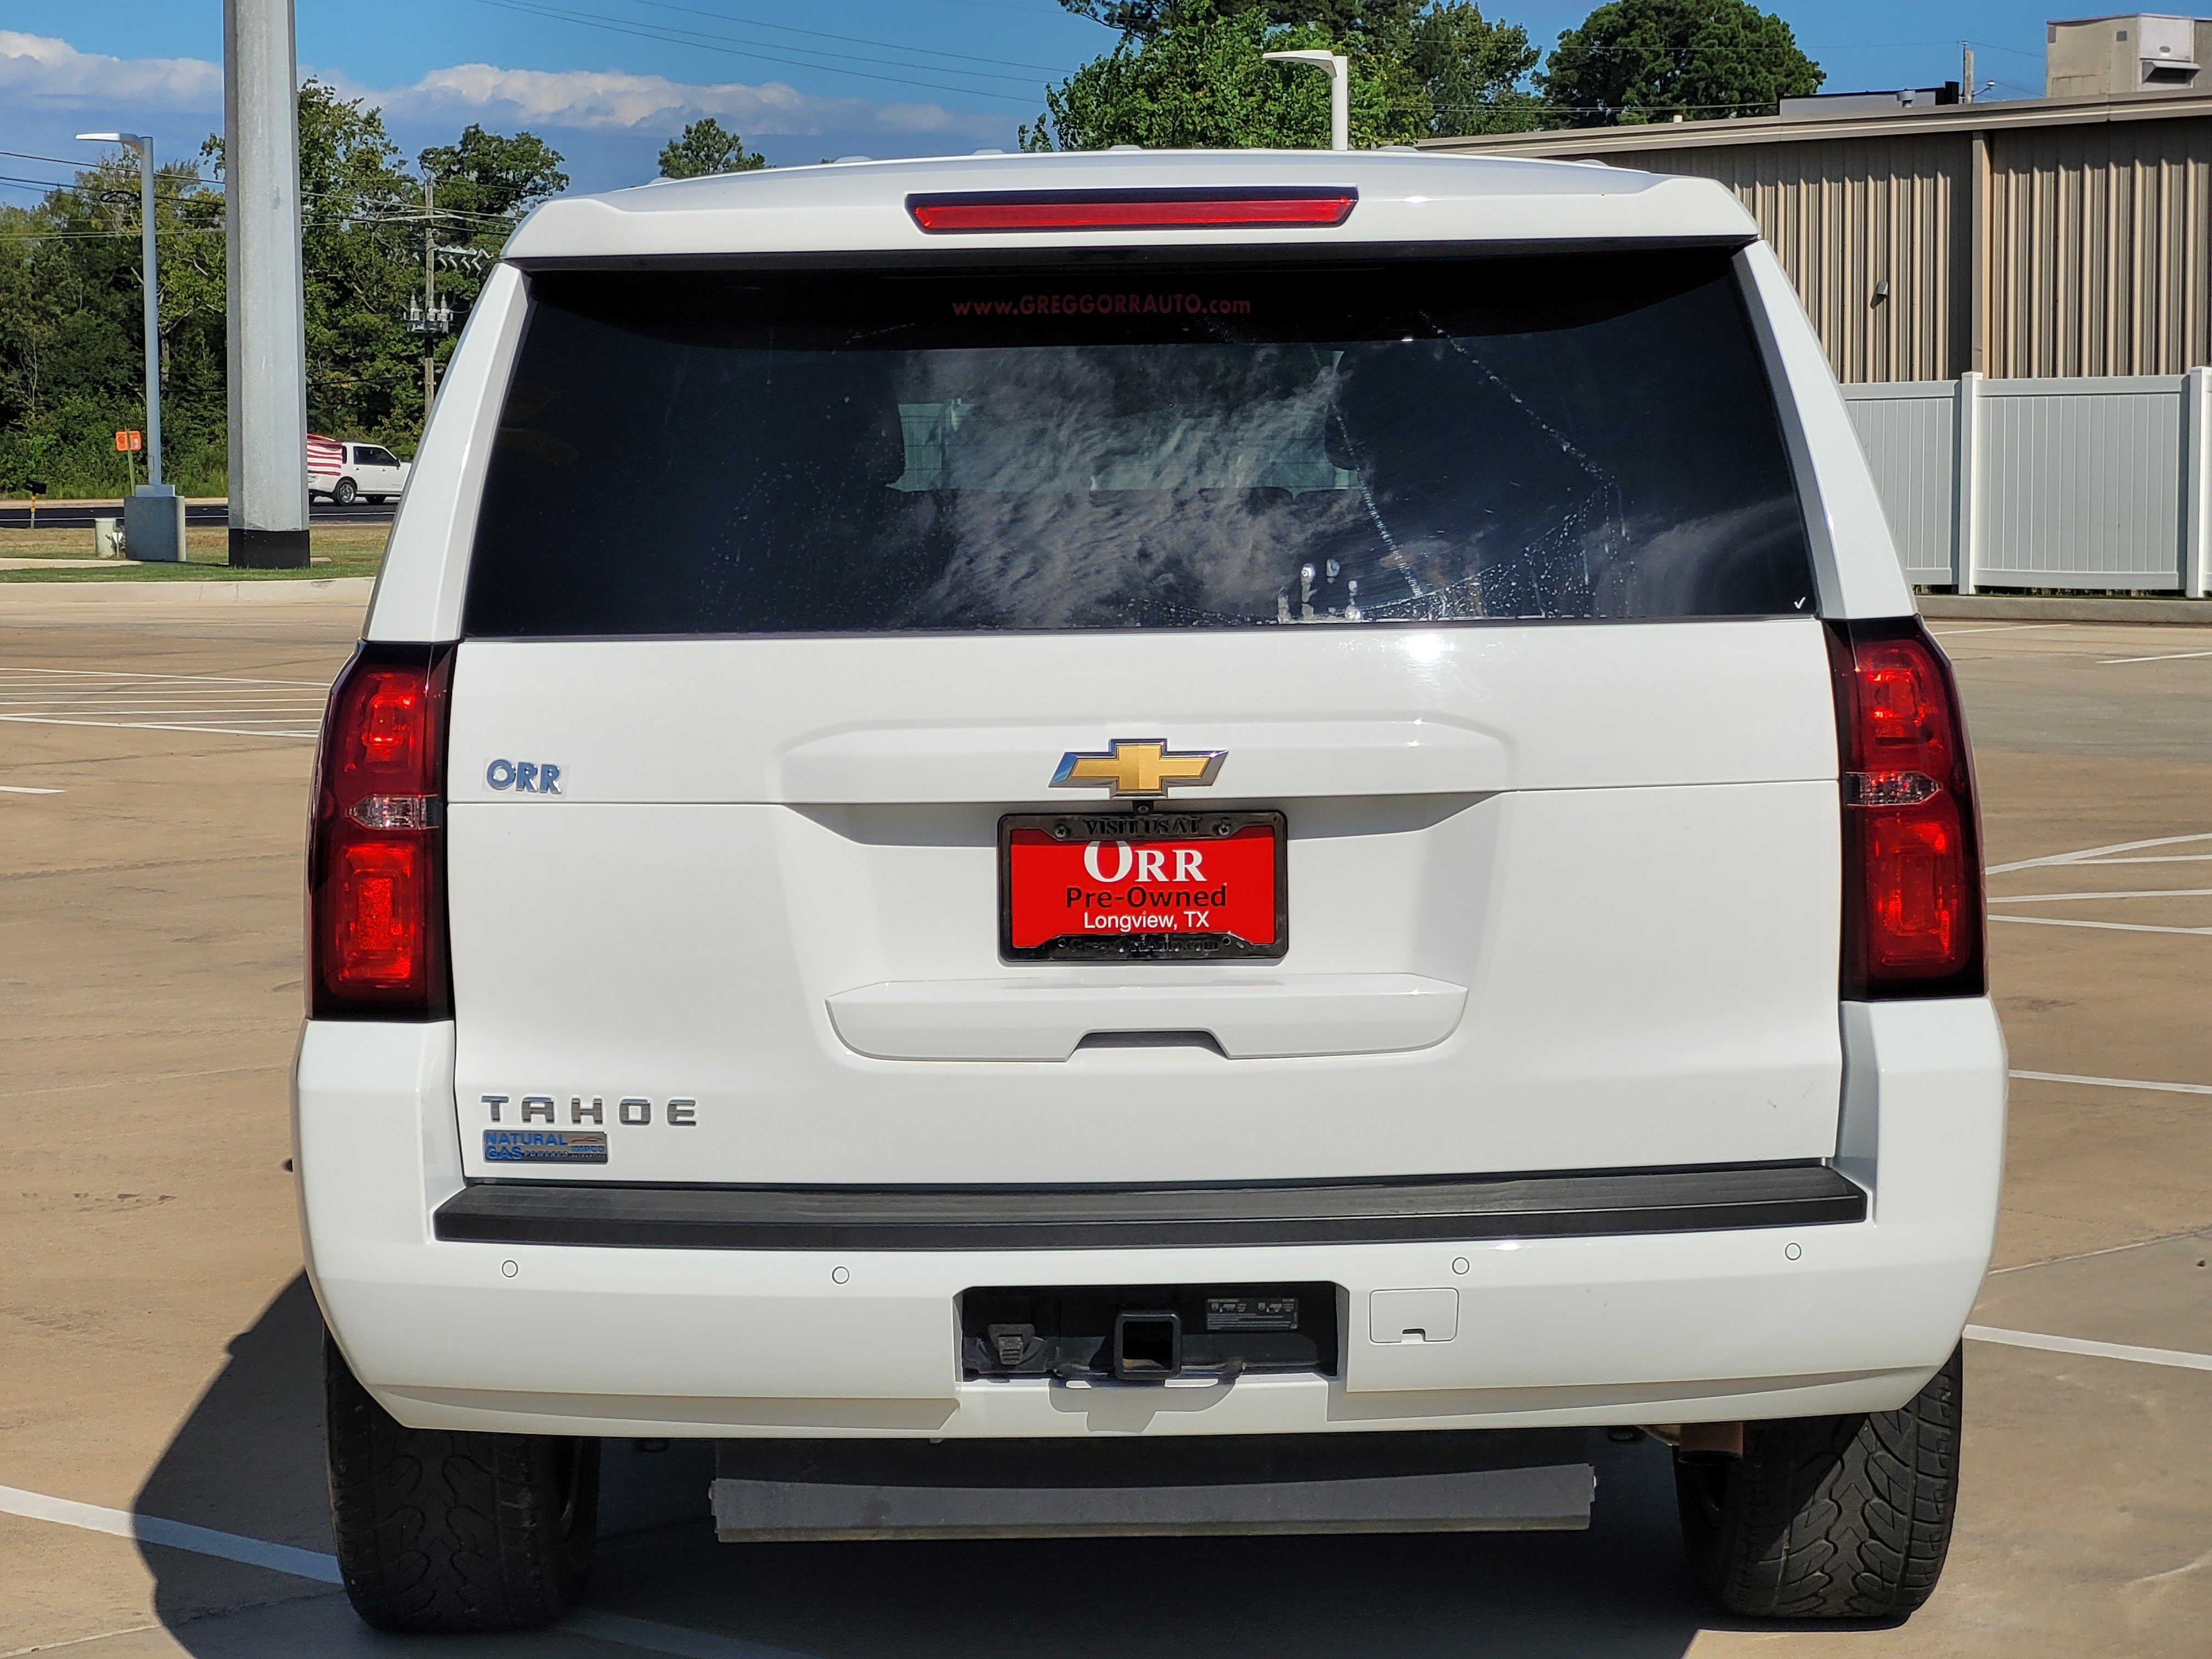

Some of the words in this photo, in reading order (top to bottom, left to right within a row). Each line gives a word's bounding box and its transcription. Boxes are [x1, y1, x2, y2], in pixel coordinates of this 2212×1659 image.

[952, 294, 1251, 316] www.GREGGORRAUTO.com
[487, 759, 562, 794] ORR
[1085, 817, 1139, 835] VISIT
[1141, 817, 1169, 835] US
[1172, 816, 1203, 834] AT
[1066, 885, 1227, 908] Pre-Owned
[1084, 911, 1177, 932] Longview,
[1183, 911, 1210, 928] TX
[481, 1096, 697, 1126] TAHOE
[484, 1132, 568, 1146] NATURAL
[485, 1146, 522, 1160] GAS
[524, 1150, 568, 1158] POWERED
